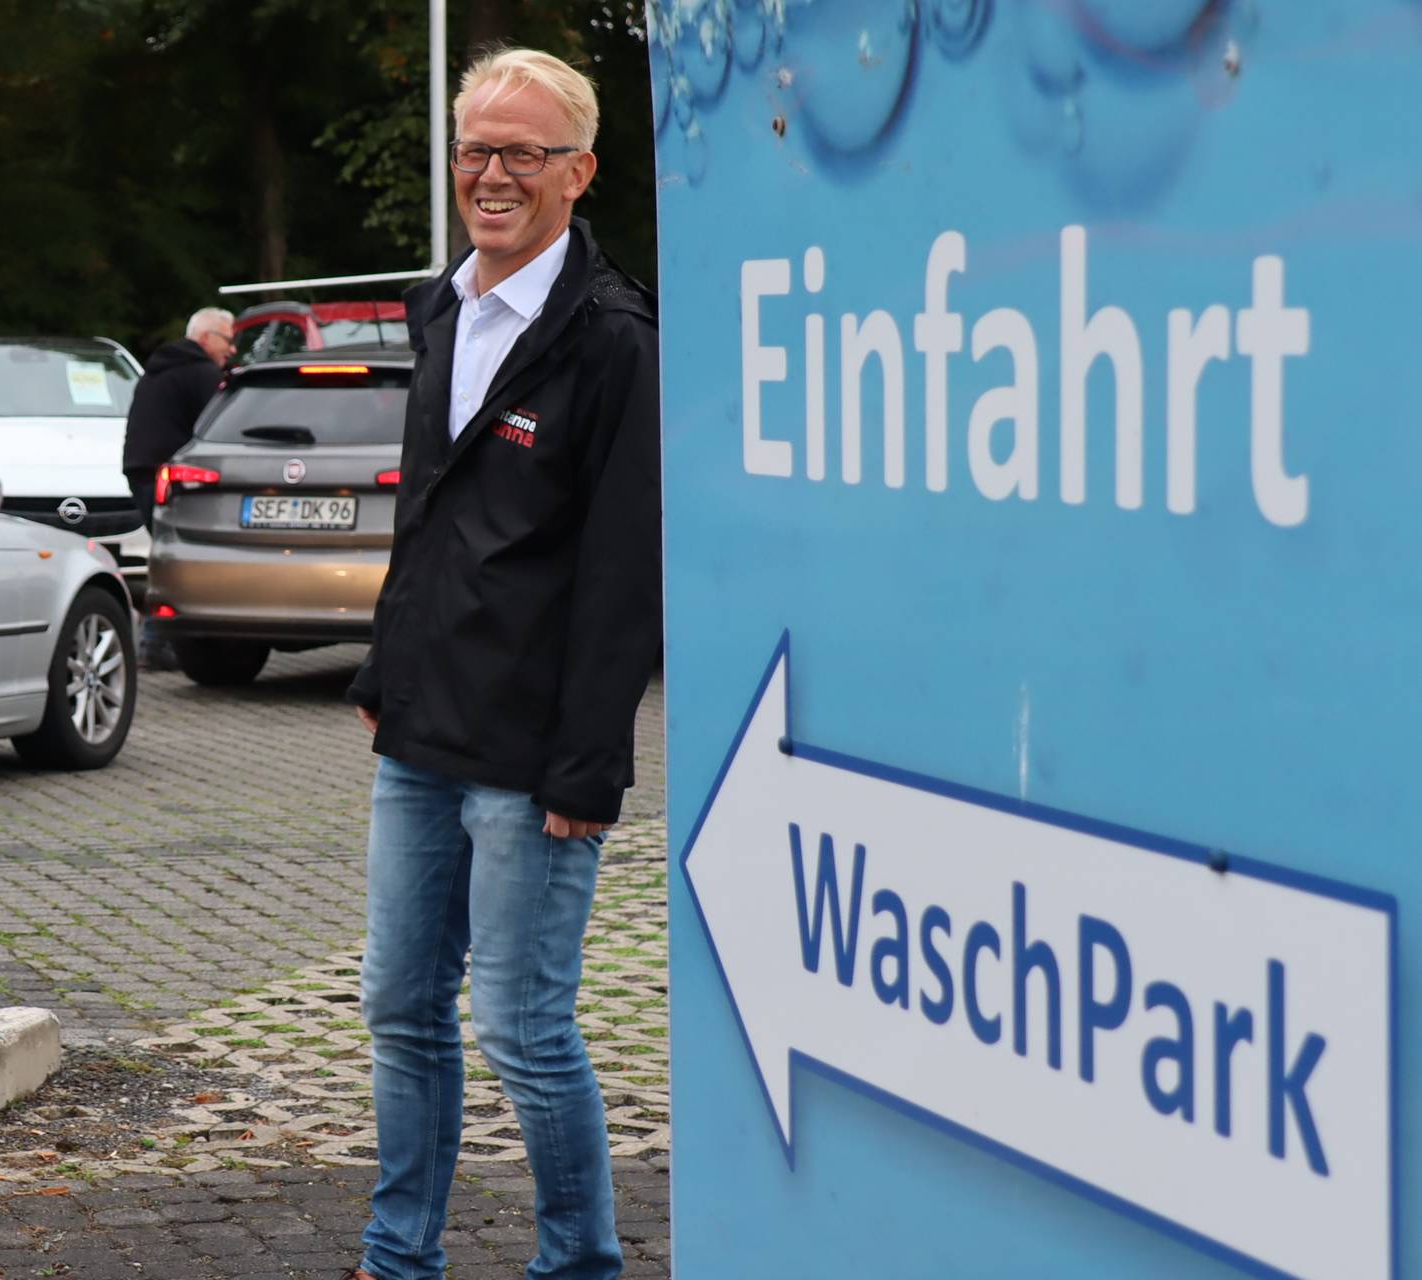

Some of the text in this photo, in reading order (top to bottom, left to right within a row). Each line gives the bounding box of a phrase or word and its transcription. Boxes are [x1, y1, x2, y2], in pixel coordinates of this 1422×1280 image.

[254, 500, 351, 520] SEF DK 96
[740, 224, 1310, 527] Einfahrt
[788, 822, 1330, 1178] WaschPark
